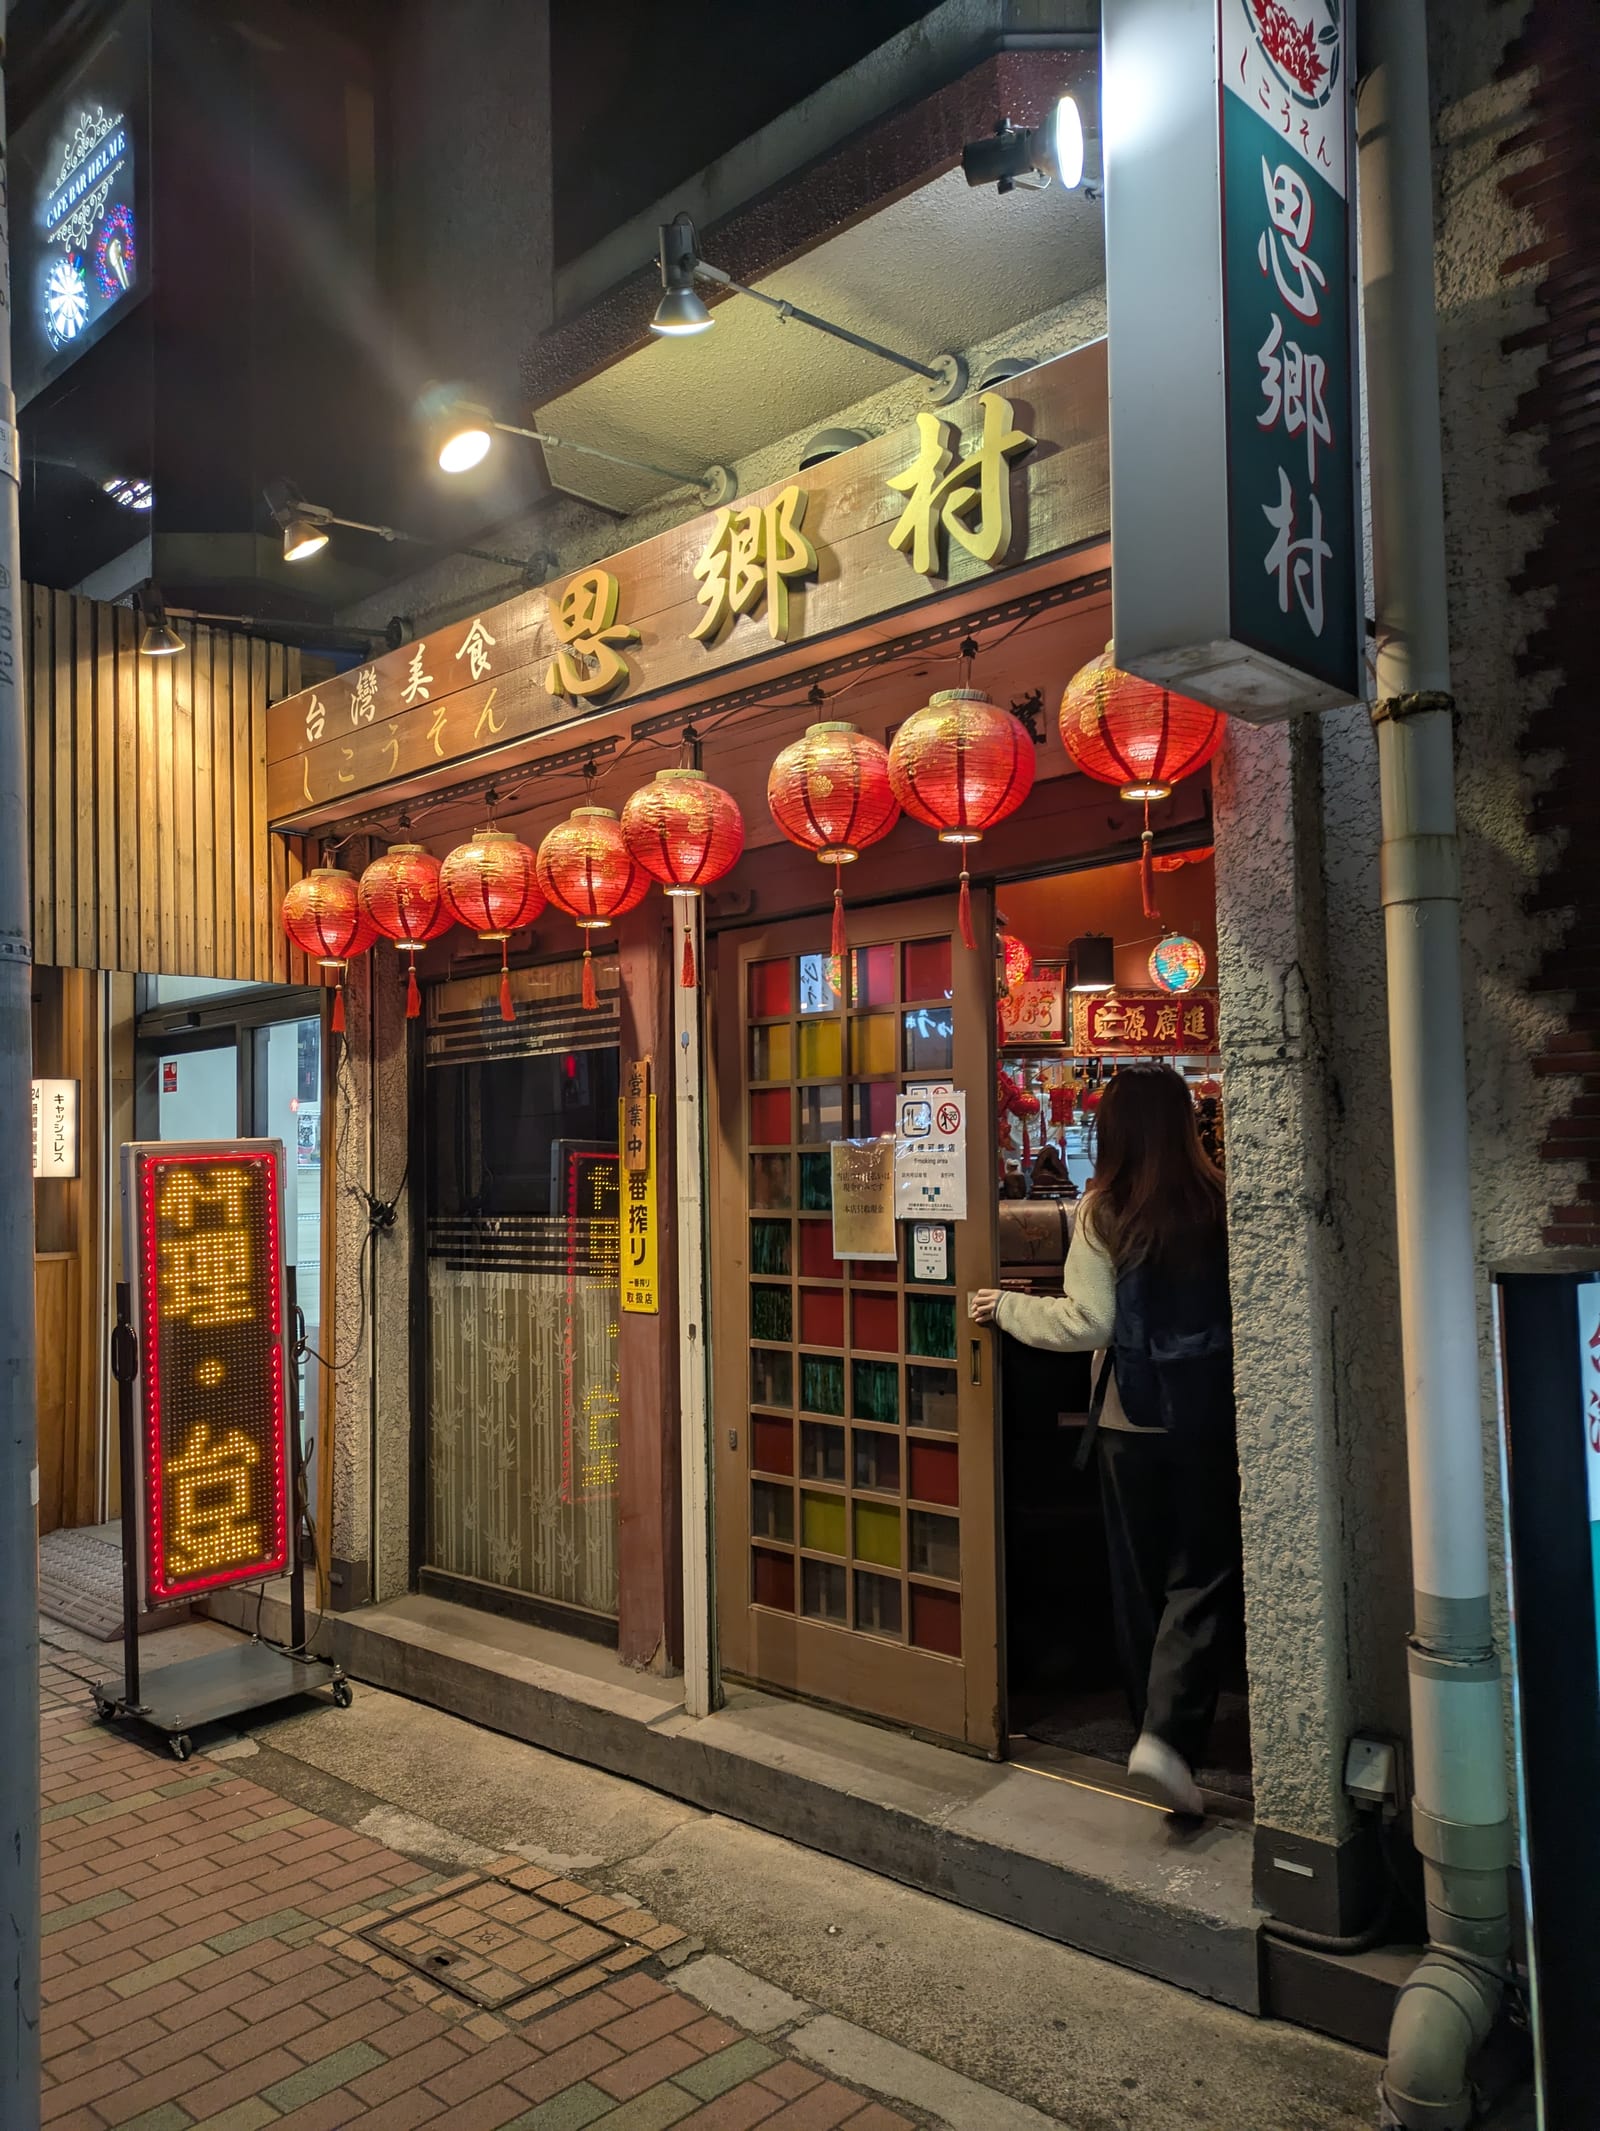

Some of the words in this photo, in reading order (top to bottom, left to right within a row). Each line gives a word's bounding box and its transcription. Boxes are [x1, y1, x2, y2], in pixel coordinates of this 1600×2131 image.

[1240, 47, 1331, 167] しこうそん
[47, 193, 69, 229] CAFE
[69, 173, 87, 204] BAR
[303, 688, 508, 803] しこうそん
[54, 1094, 64, 1162] キャッシュレス
[628, 1074, 643, 1158] 営業中
[627, 1292, 653, 1305] 取扱店
